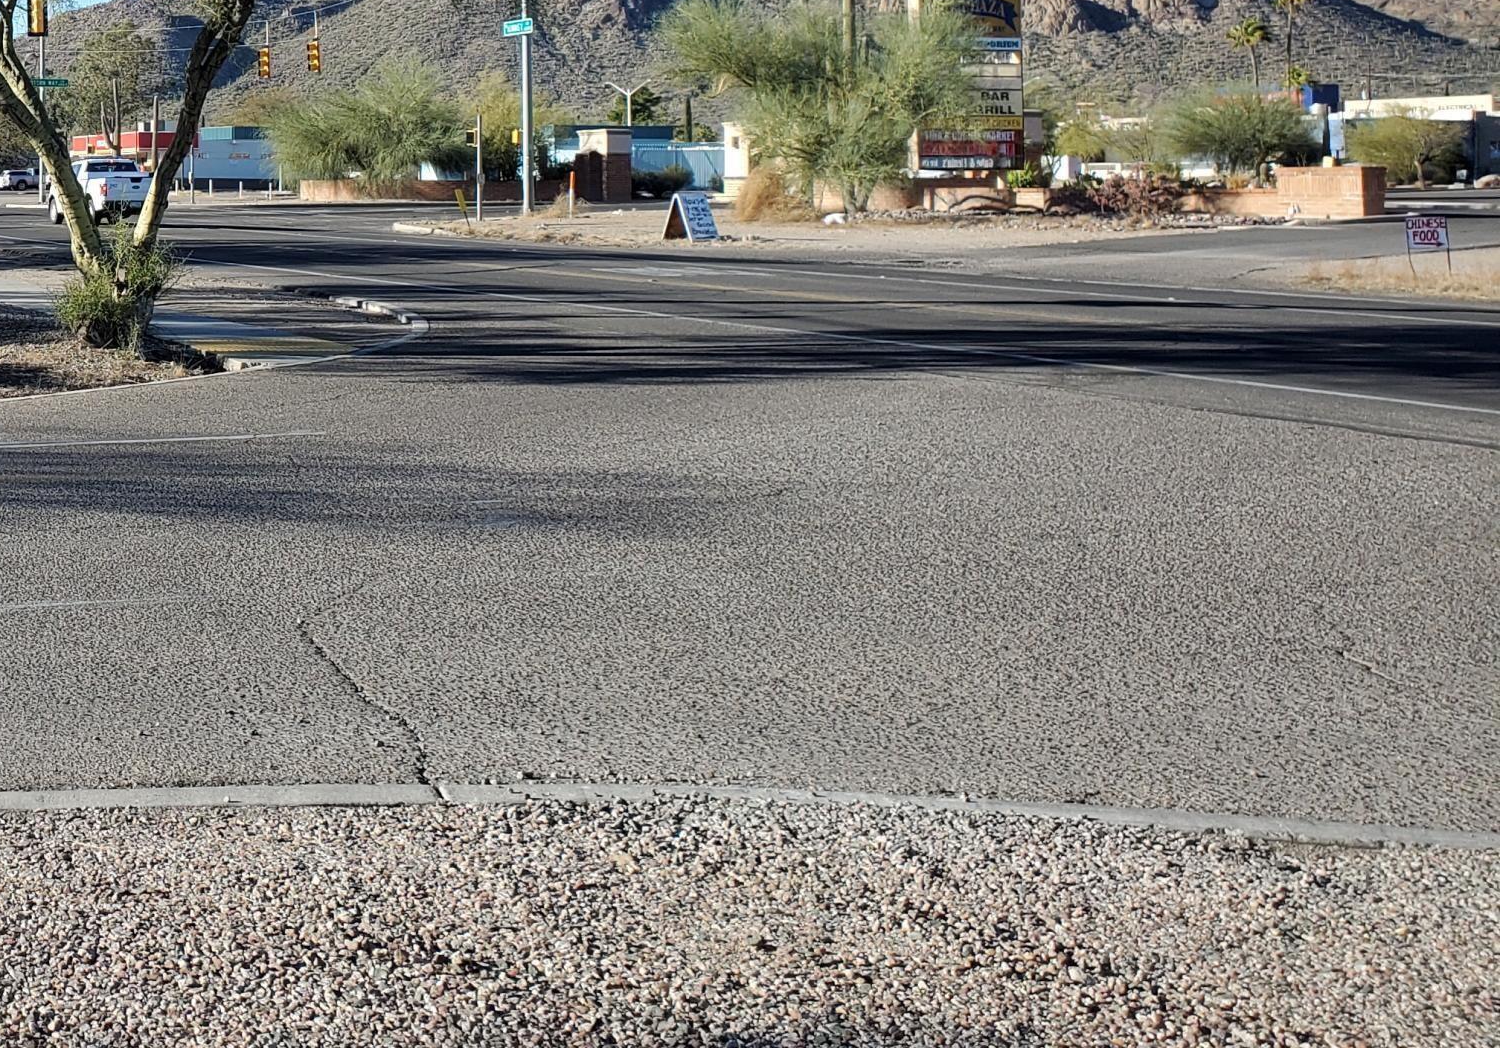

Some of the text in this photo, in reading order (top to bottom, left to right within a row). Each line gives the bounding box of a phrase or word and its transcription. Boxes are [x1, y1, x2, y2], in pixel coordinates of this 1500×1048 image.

[981, 91, 1009, 101] BAR
[1406, 217, 1446, 229] CHINESE
[1412, 229, 1439, 242] FOOD
